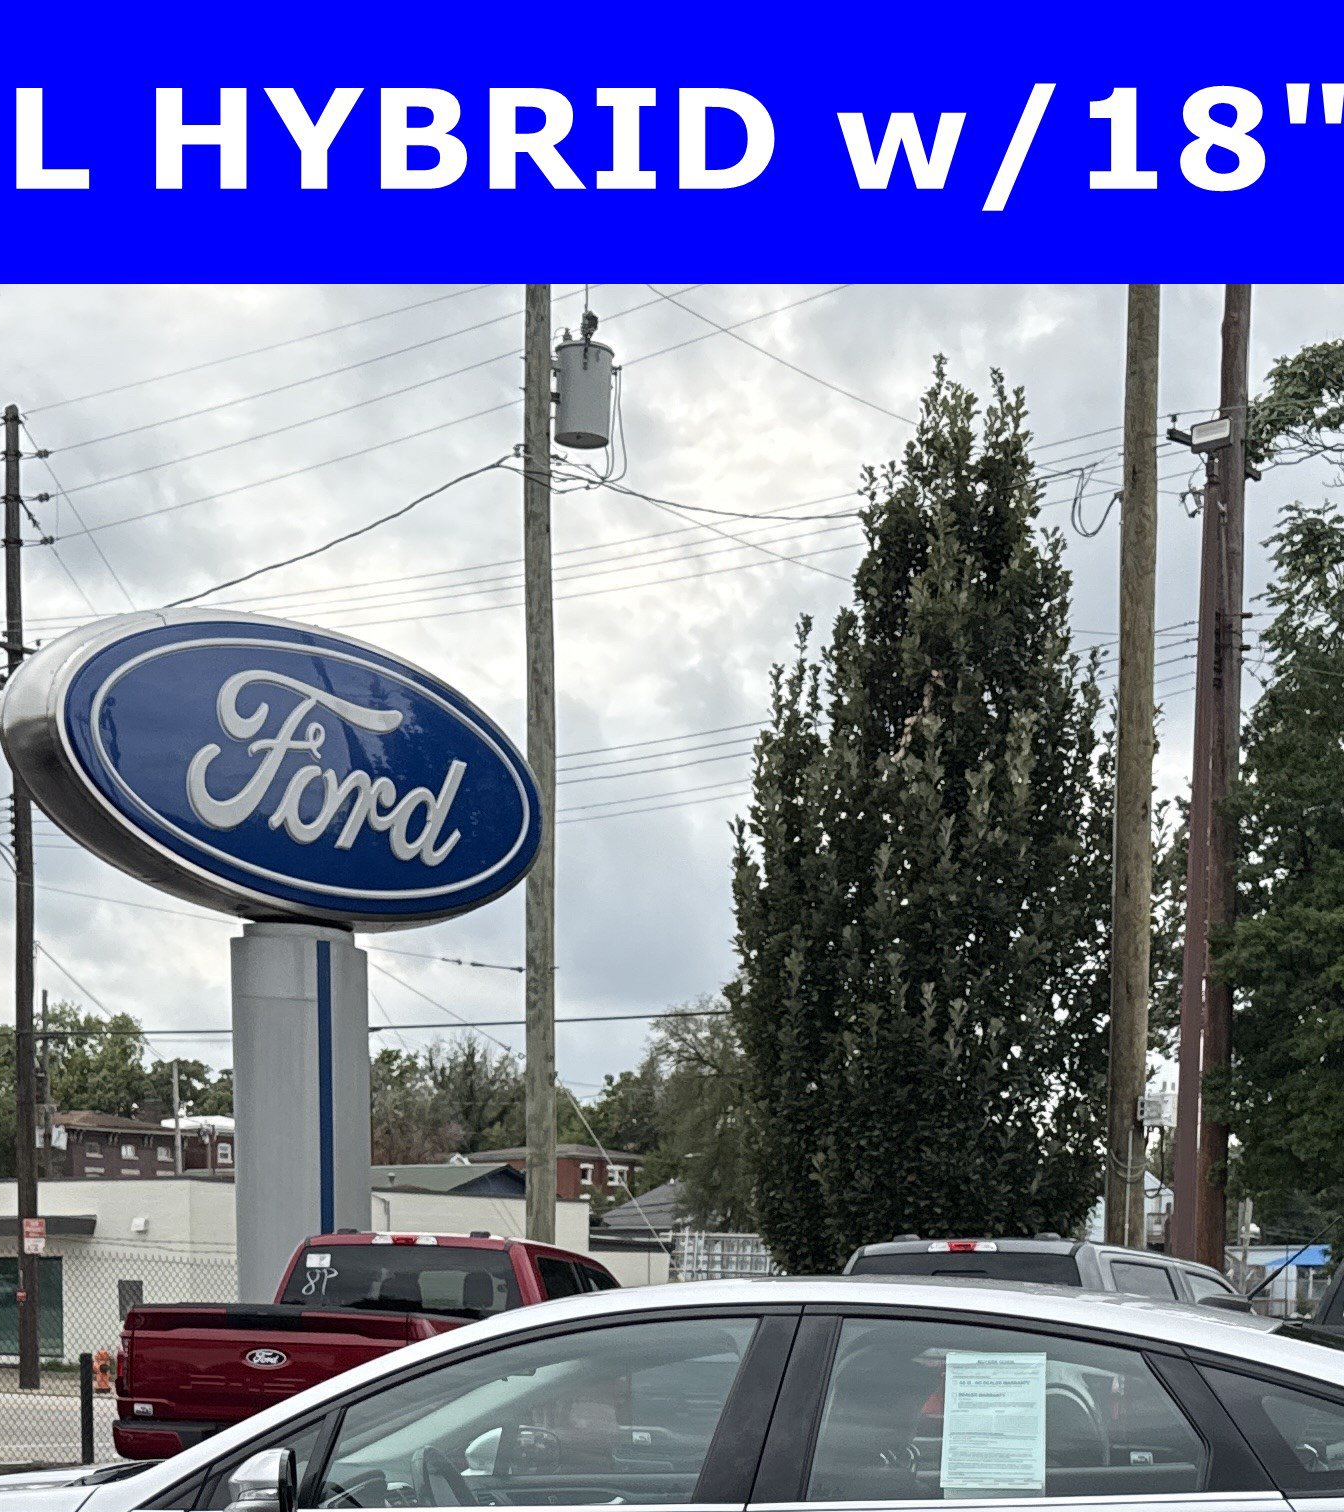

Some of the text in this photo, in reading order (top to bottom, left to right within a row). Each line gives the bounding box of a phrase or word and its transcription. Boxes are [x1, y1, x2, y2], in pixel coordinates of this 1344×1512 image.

[186, 669, 467, 867] Ford
[301, 1267, 339, 1296] 8P
[252, 1351, 280, 1364] Ford
